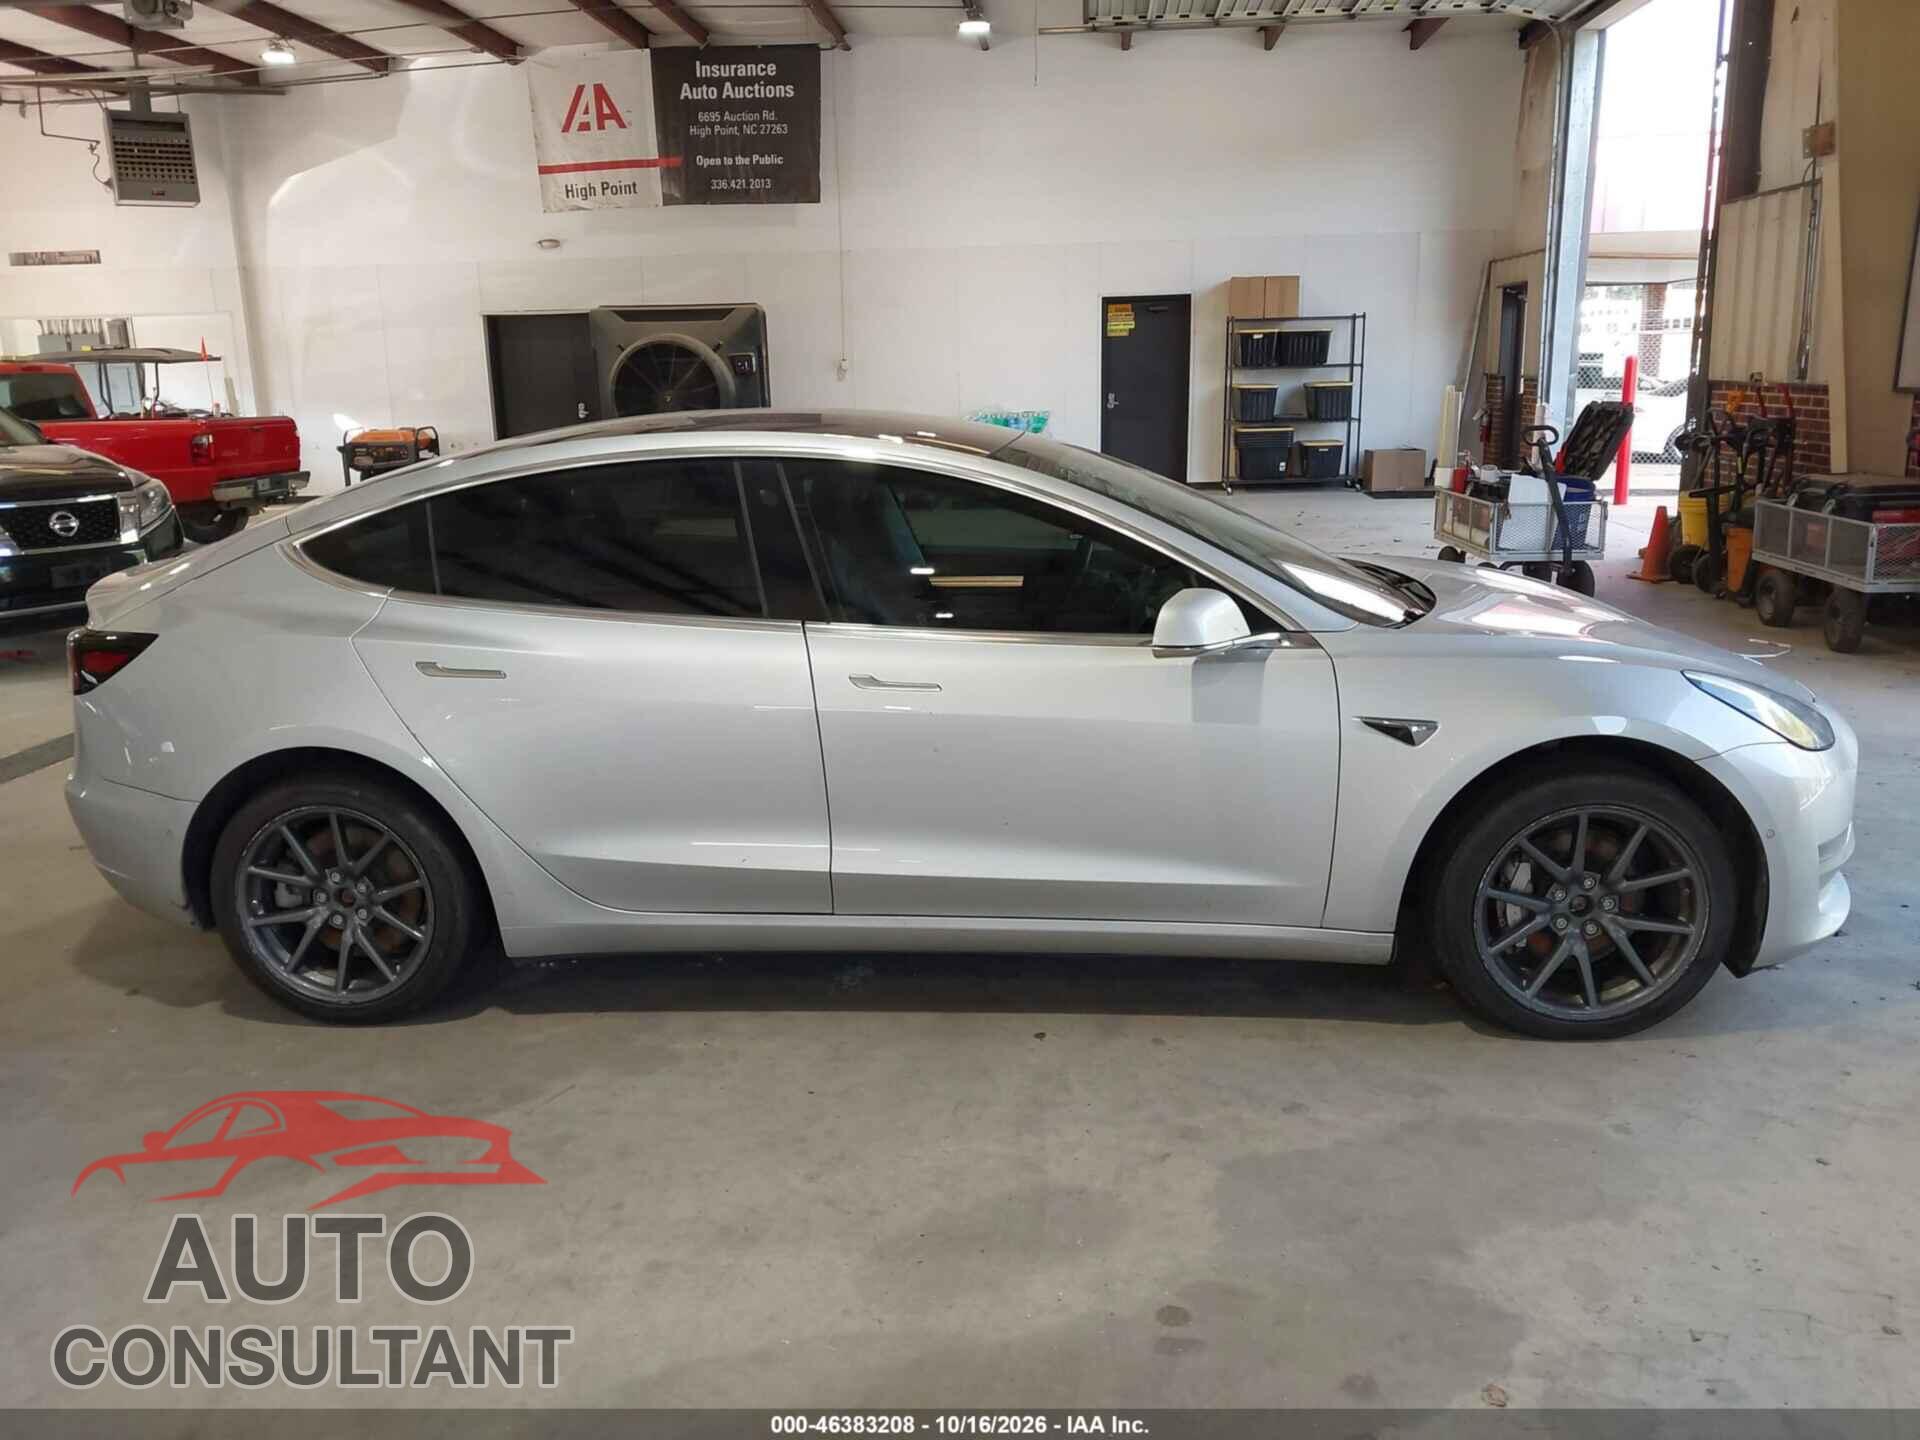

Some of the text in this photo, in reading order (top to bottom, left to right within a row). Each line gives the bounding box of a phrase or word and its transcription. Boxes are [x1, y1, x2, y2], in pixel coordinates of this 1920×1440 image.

[696, 60, 777, 78] Insurance
[680, 80, 795, 100] Auto Auctions
[698, 110, 778, 122] 6695 Auction Rd.
[689, 123, 788, 138] High Point, NC 27263
[696, 154, 784, 168] Open to the Public
[564, 180, 638, 201] High Point
